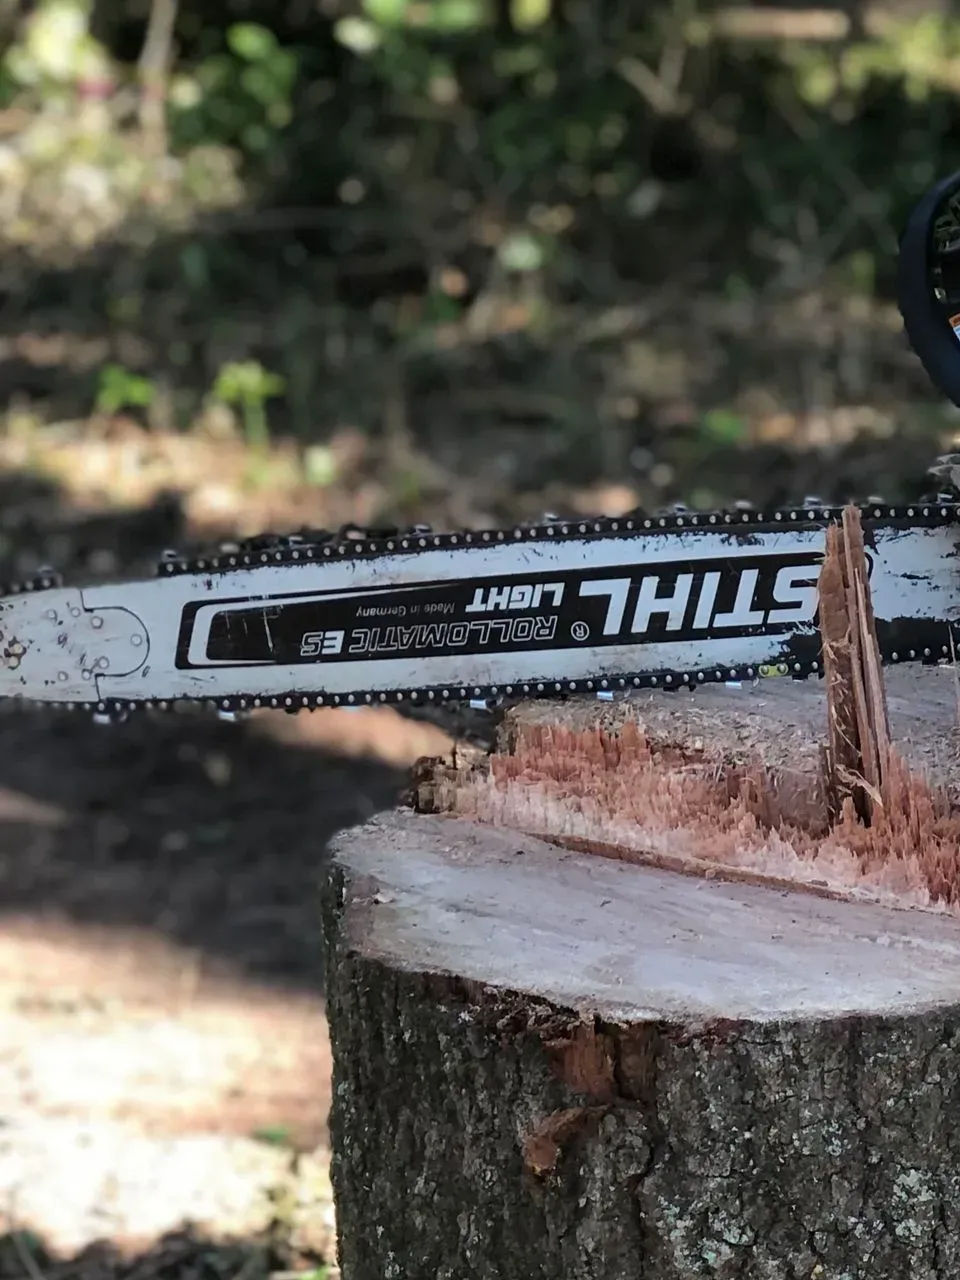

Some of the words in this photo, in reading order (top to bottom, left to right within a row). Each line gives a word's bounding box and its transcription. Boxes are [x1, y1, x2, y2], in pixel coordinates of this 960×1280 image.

[410, 603, 421, 615] in
[424, 602, 455, 614] Made
[464, 582, 565, 613] LIGHT
[578, 564, 825, 636] STIHL
[356, 605, 407, 617] Germany
[300, 630, 345, 656] ES
[349, 615, 558, 653] ROLLOMATIC
